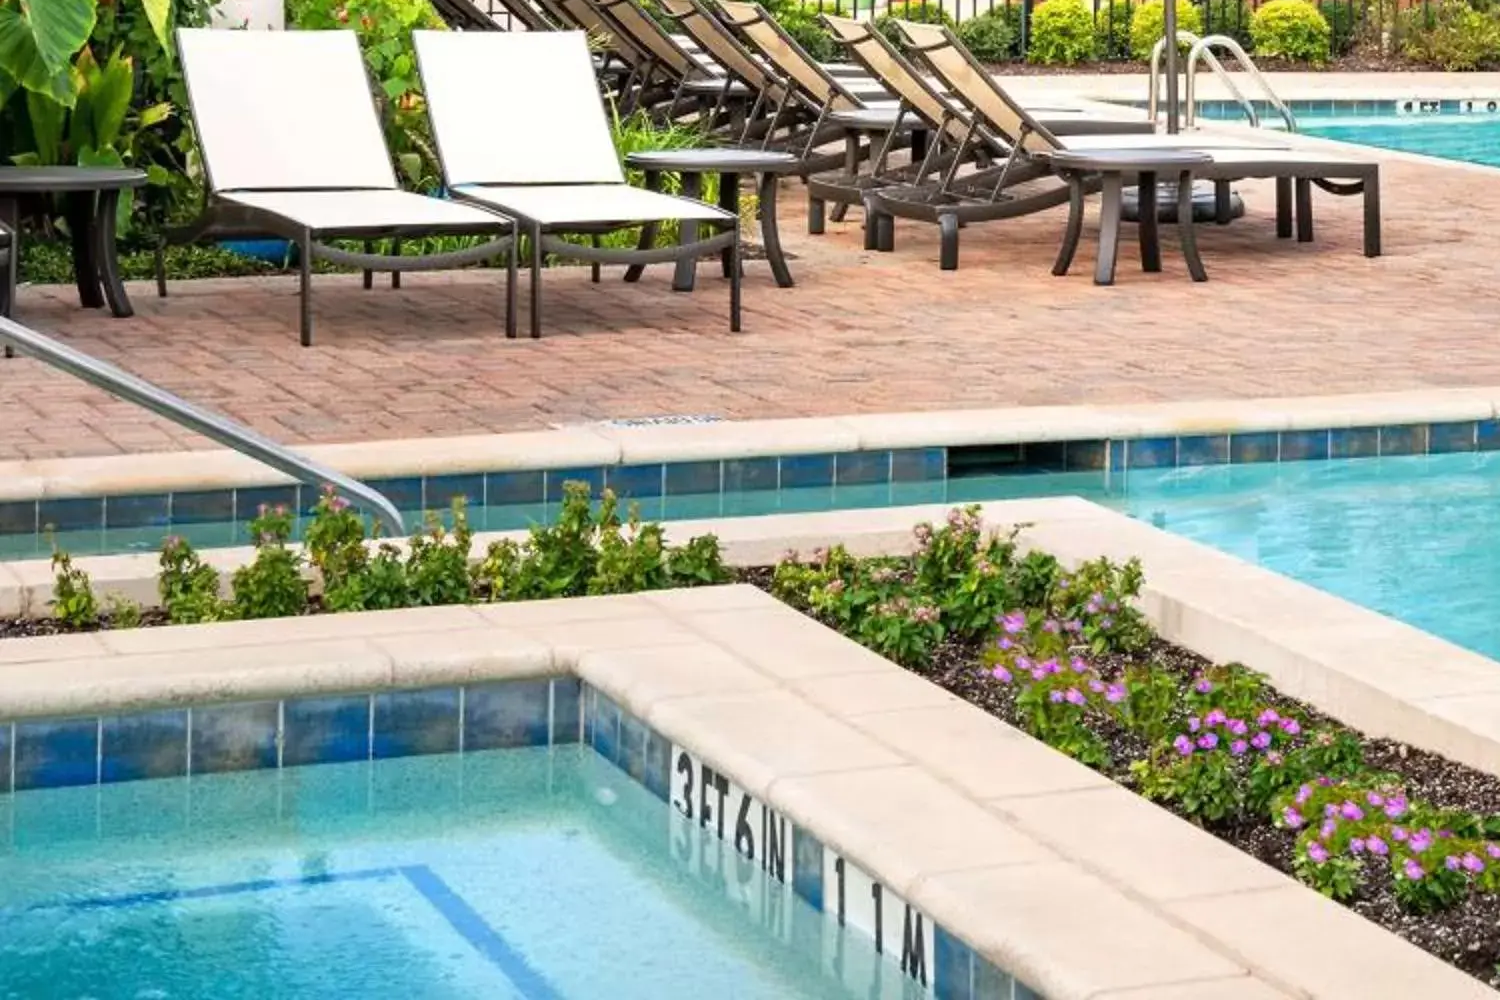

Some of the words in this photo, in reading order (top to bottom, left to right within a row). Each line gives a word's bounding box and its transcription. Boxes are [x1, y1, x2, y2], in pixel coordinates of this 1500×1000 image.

[673, 751, 694, 820] 3
[700, 763, 729, 840] FT
[734, 792, 755, 860] 6
[761, 803, 786, 885] IN
[835, 856, 846, 928] 1
[871, 881, 883, 956] 1
[900, 903, 927, 988] M
